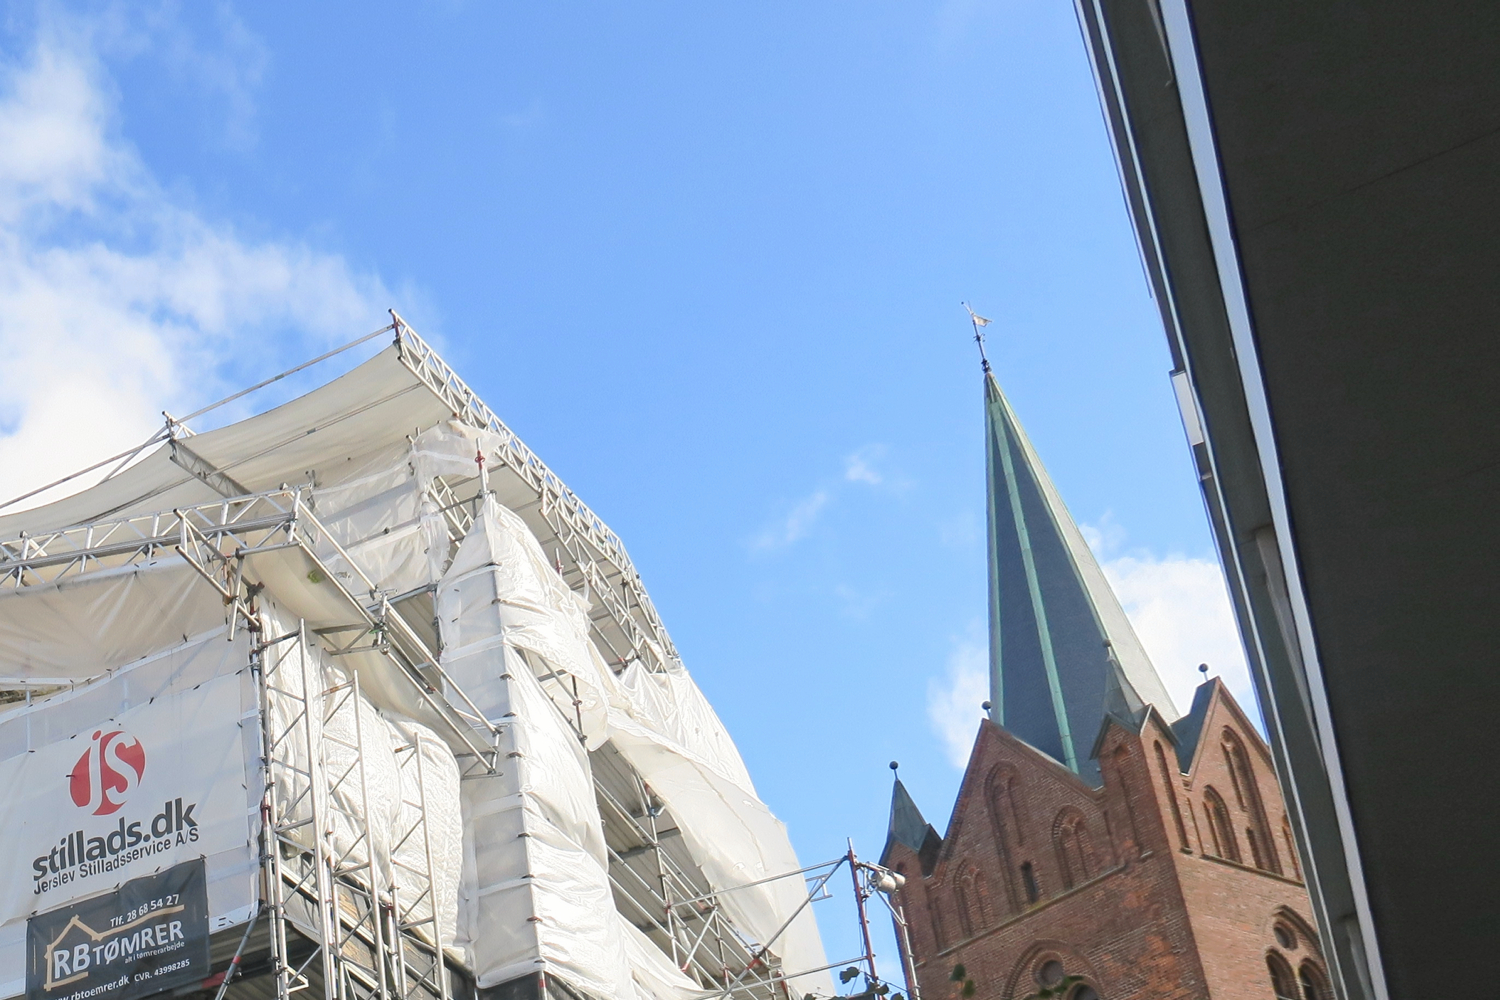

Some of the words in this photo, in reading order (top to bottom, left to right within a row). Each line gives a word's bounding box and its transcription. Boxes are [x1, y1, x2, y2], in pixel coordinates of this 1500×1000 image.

[32, 797, 198, 882] stillads.dk
[33, 870, 76, 895] Jerslev
[79, 838, 172, 879] Stilladsservice
[175, 827, 200, 847] A/S
[109, 917, 125, 928] Tlf.
[126, 910, 137, 923] 28
[138, 902, 149, 916] 68
[150, 898, 163, 910] 54
[166, 893, 180, 906] 27
[124, 955, 133, 964] alt
[136, 941, 185, 960] tømrerarbejde
[134, 971, 153, 982] CVR.
[154, 958, 191, 976] 43998285
